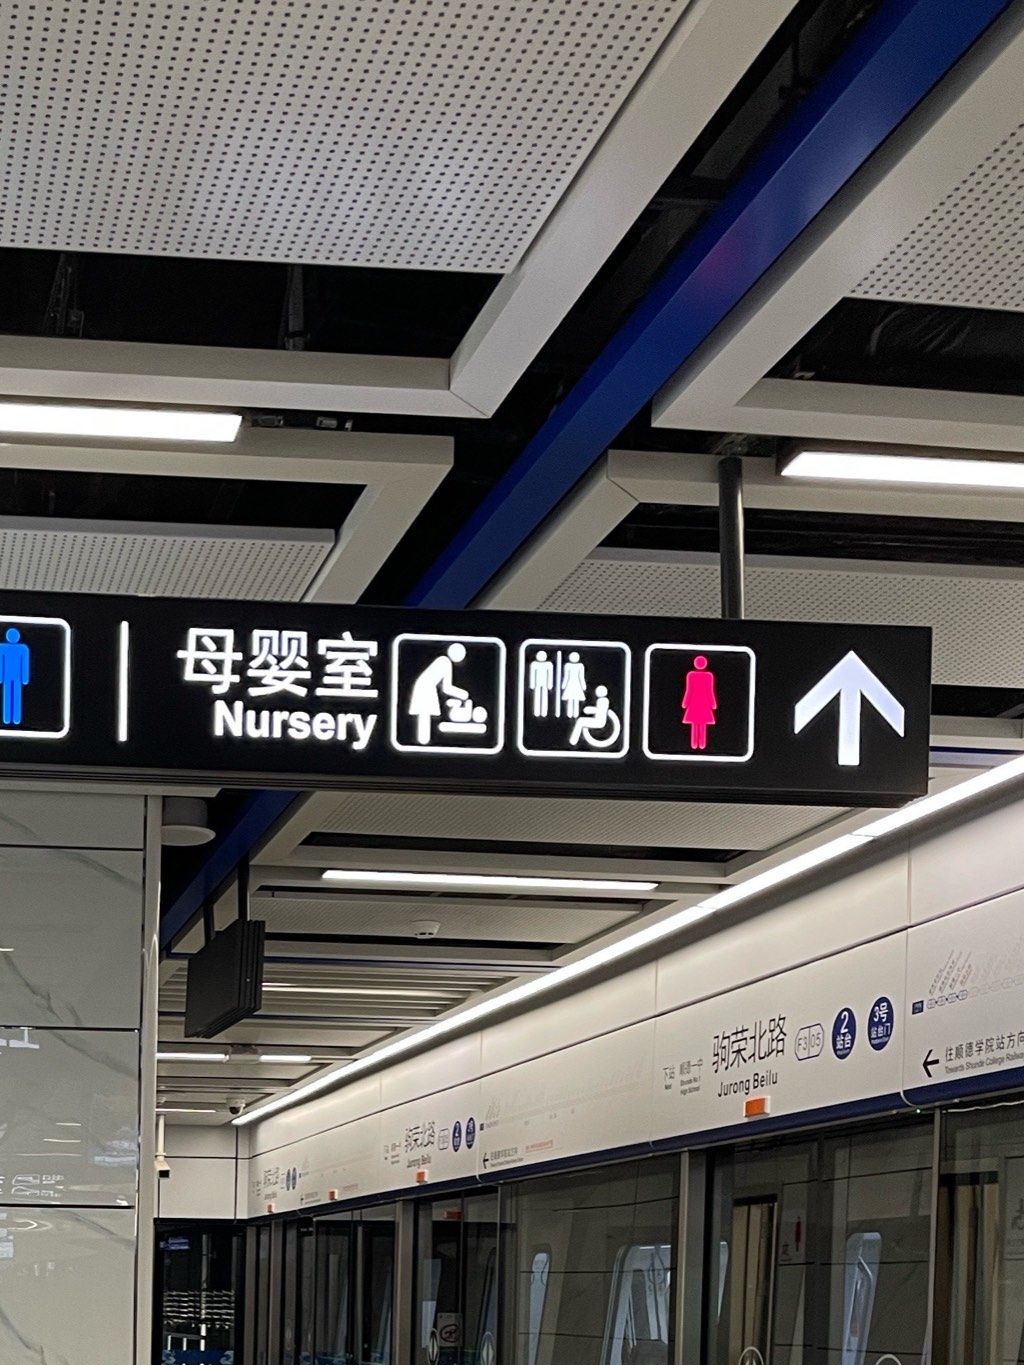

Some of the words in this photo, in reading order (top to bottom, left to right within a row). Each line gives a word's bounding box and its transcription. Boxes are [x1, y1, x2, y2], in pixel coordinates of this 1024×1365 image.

[176, 625, 380, 700] 母婴室
[214, 698, 377, 750] Nursery
[841, 1011, 849, 1033] 2
[873, 1002, 888, 1022] 3号
[712, 1013, 787, 1073] 驹荣北路
[718, 1079, 750, 1097] Jurong
[753, 1070, 778, 1089] Beilu
